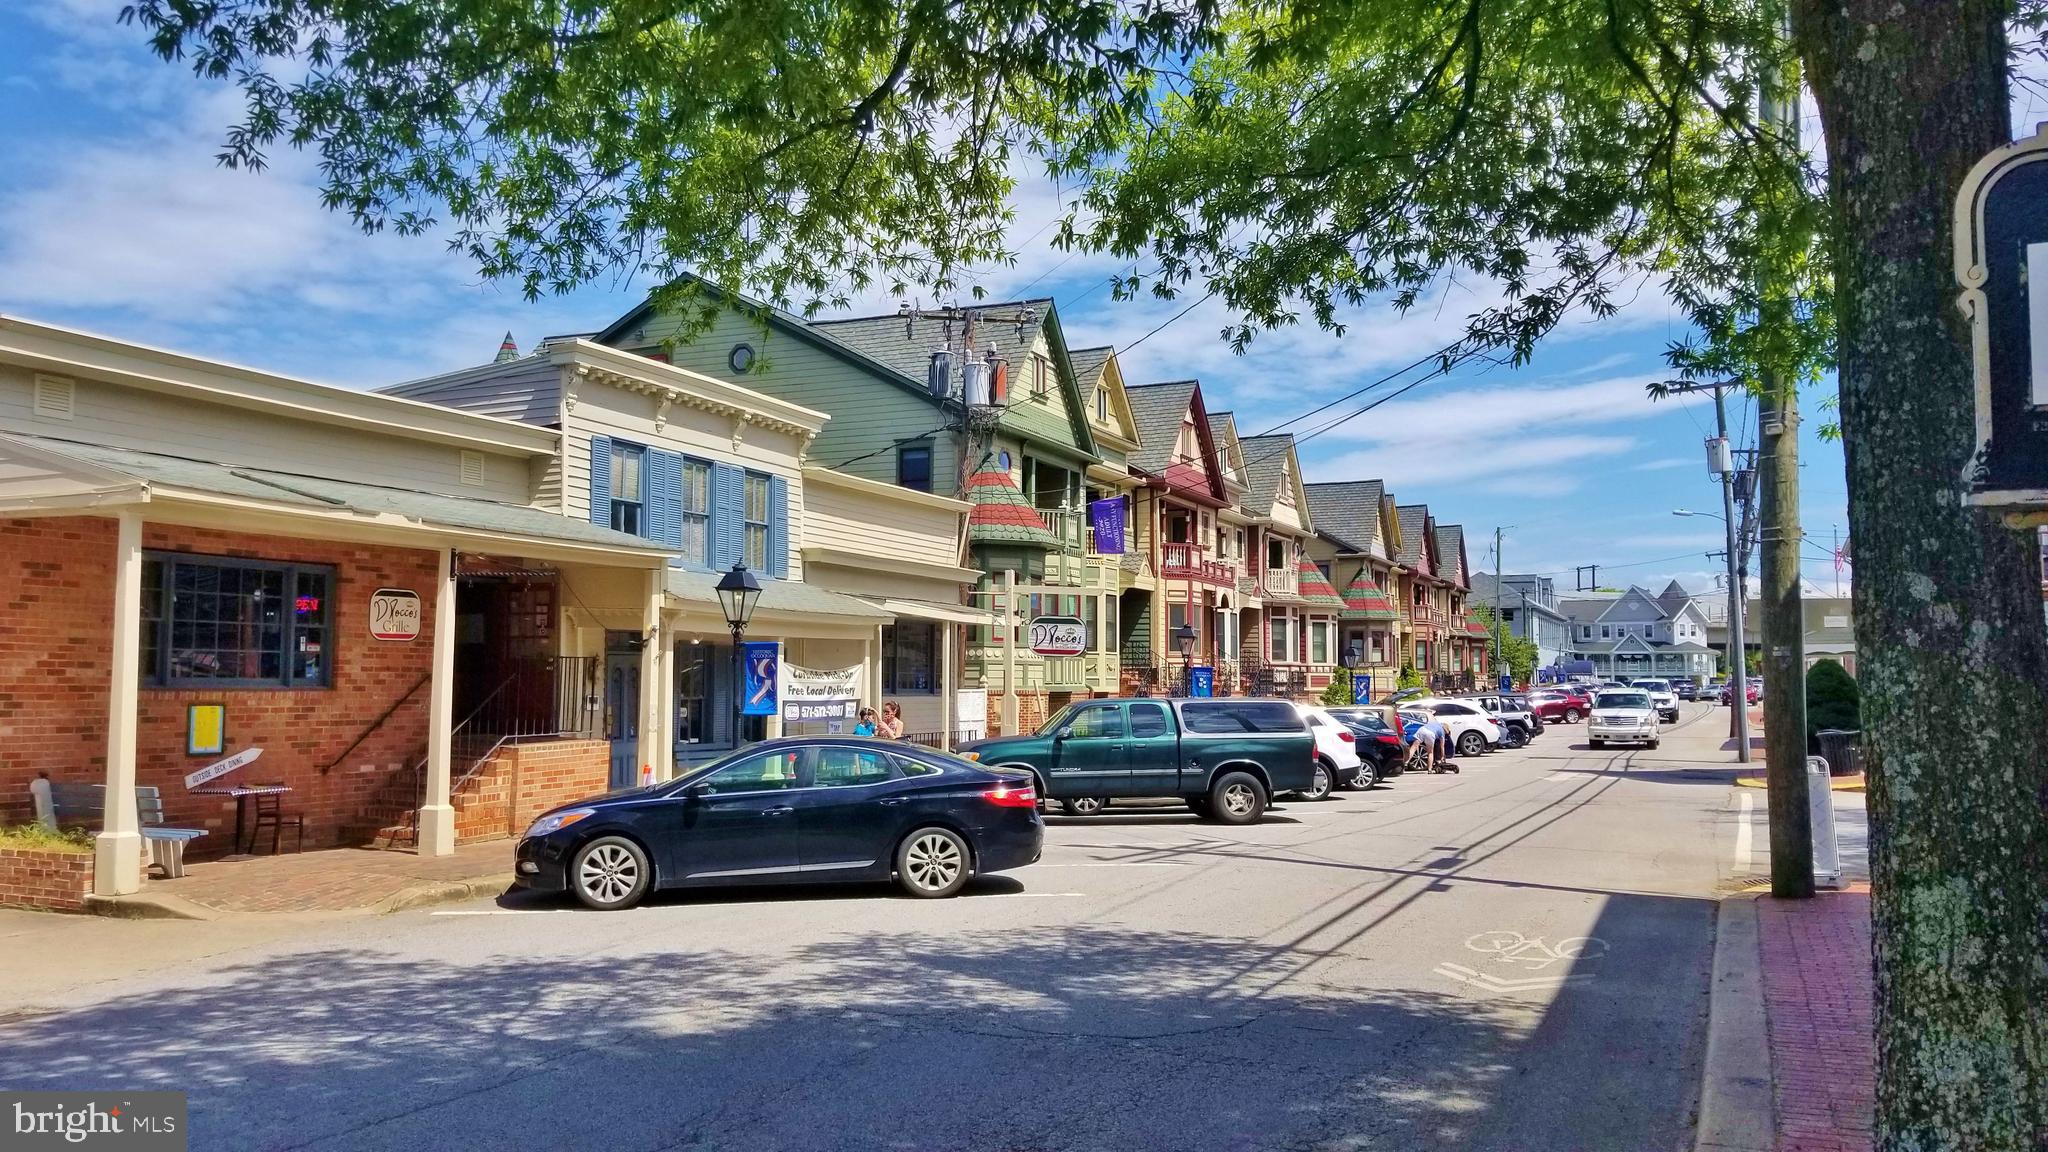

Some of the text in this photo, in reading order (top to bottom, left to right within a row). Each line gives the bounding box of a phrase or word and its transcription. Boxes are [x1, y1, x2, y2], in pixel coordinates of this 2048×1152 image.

[1103, 516, 1113, 538] ADULT
[295, 599, 319, 611] PEN
[382, 620, 410, 632] Grille
[787, 685, 856, 697] Free Local Delivery
[192, 756, 244, 784] OUTSIDE DECK DINING
